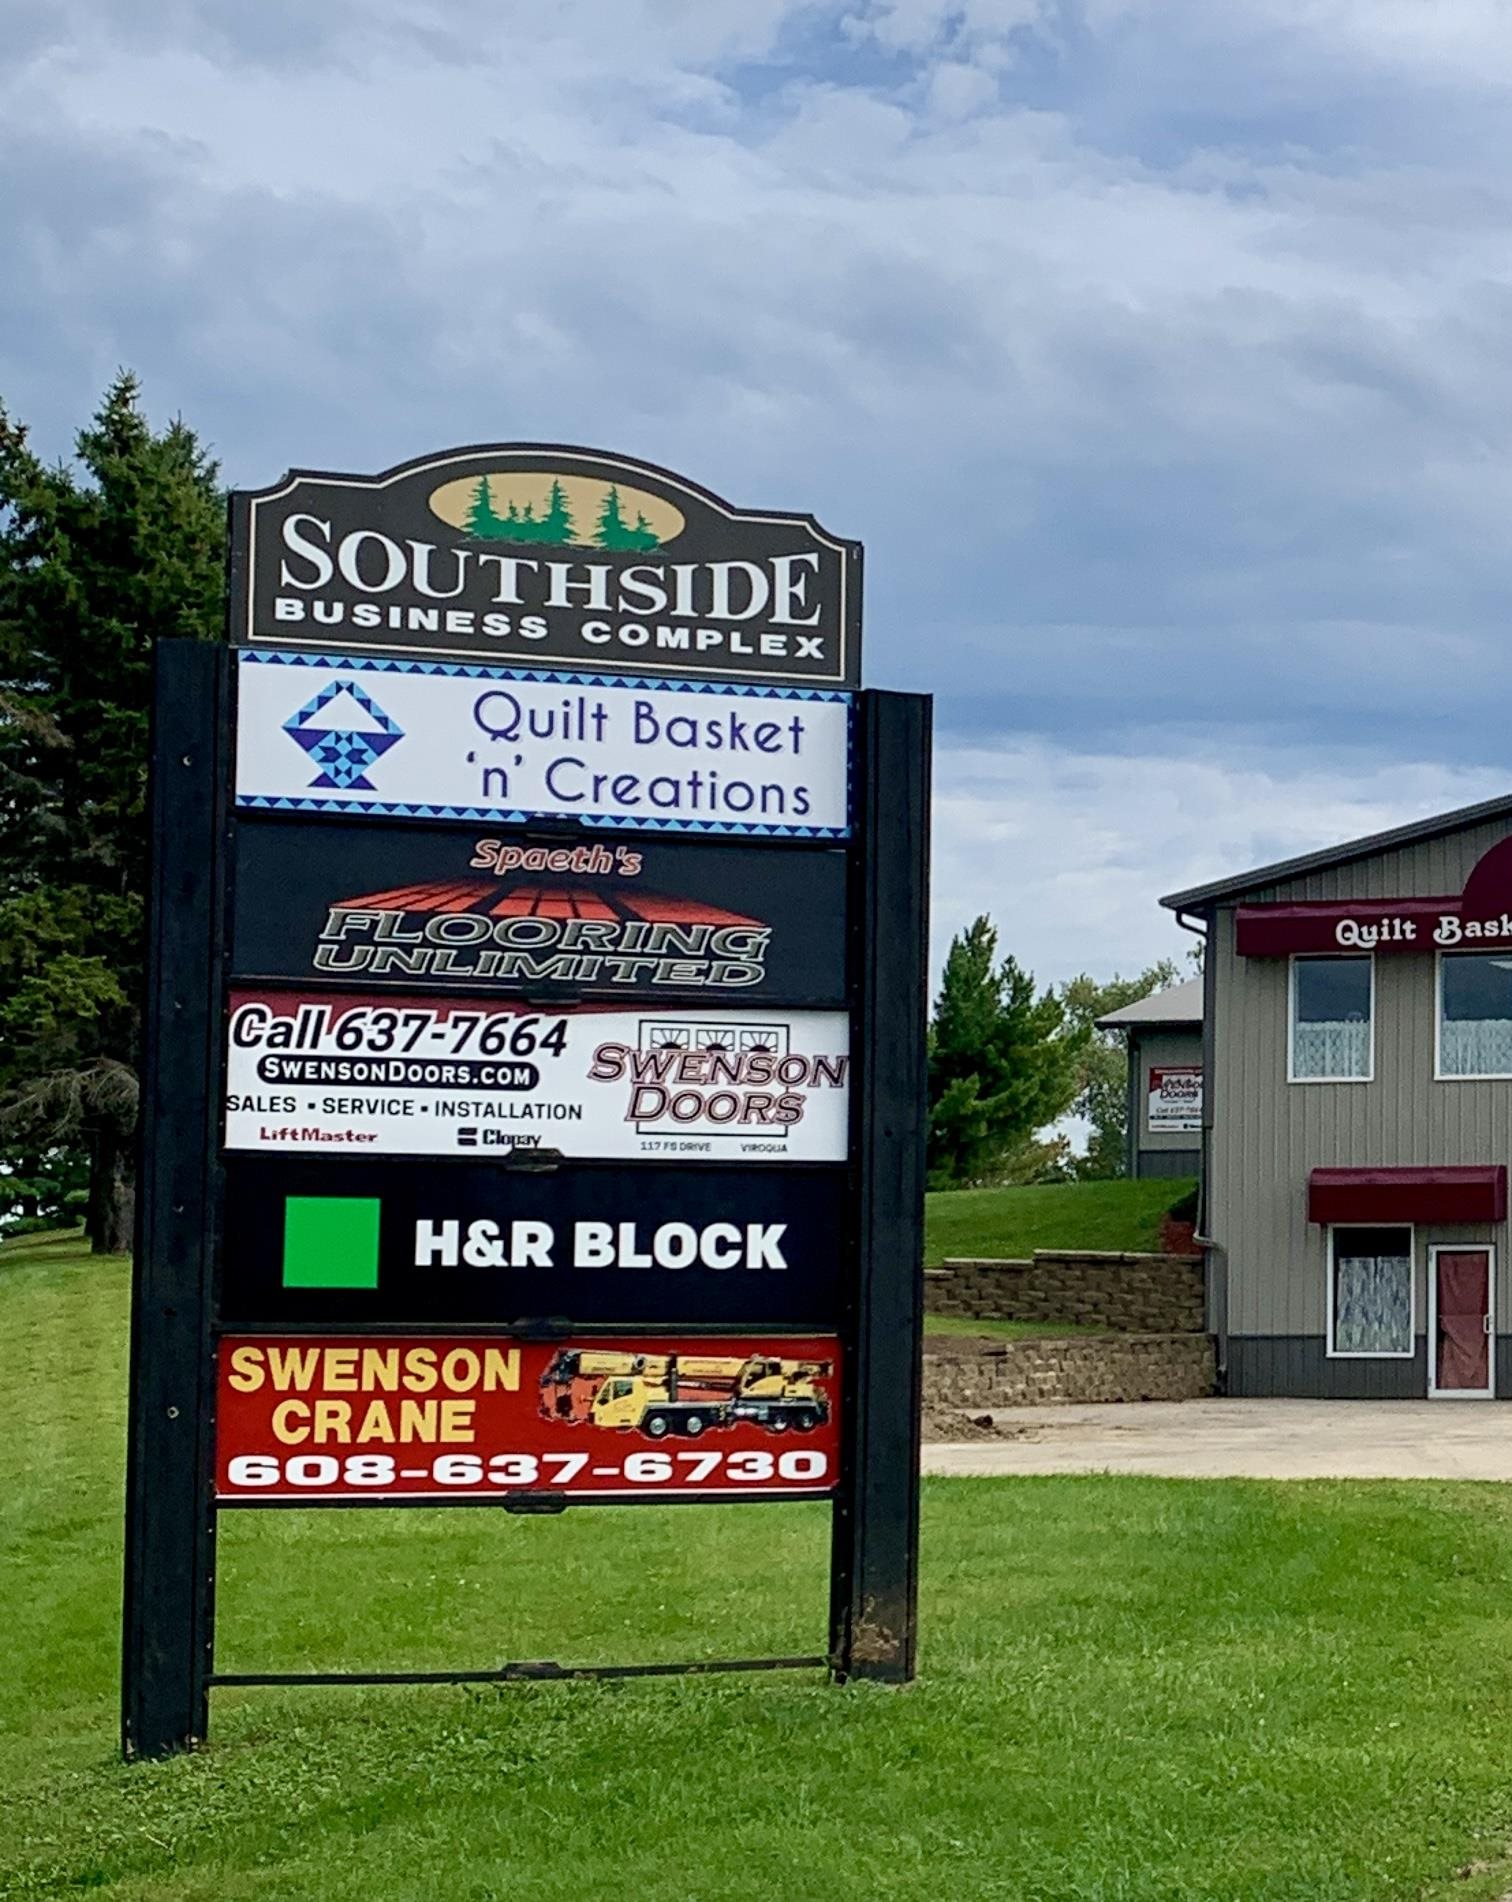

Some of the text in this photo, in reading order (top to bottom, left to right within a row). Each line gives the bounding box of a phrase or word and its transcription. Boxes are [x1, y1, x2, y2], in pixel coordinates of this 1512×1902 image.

[280, 513, 823, 627] SOUTHSIDE
[274, 597, 825, 660] BUSINESS COMPLEX
[473, 689, 806, 755] Quilt Basket
[545, 757, 811, 817] Creations
[470, 838, 642, 877] Spaeth's
[319, 907, 772, 960] FLOORING
[1335, 918, 1417, 949] Quilt
[313, 944, 767, 987] UNLIMITED
[231, 1006, 569, 1058] Call 637-7664
[586, 1041, 849, 1088] SWENSON
[226, 1095, 582, 1120] SALES SERVICE INSTALLATION
[624, 1083, 807, 1125] DOORS
[260, 1126, 378, 1144] LiftMaster
[482, 1128, 542, 1149] Clopay
[640, 1141, 661, 1151] 117
[679, 1142, 711, 1152] DRIVE
[740, 1143, 788, 1152] VIROQUA
[414, 1219, 789, 1270] H&R BLOCK
[228, 1347, 521, 1392] SWENSON
[272, 1400, 475, 1443] CRANE
[227, 1450, 828, 1487] 608-637-6730
